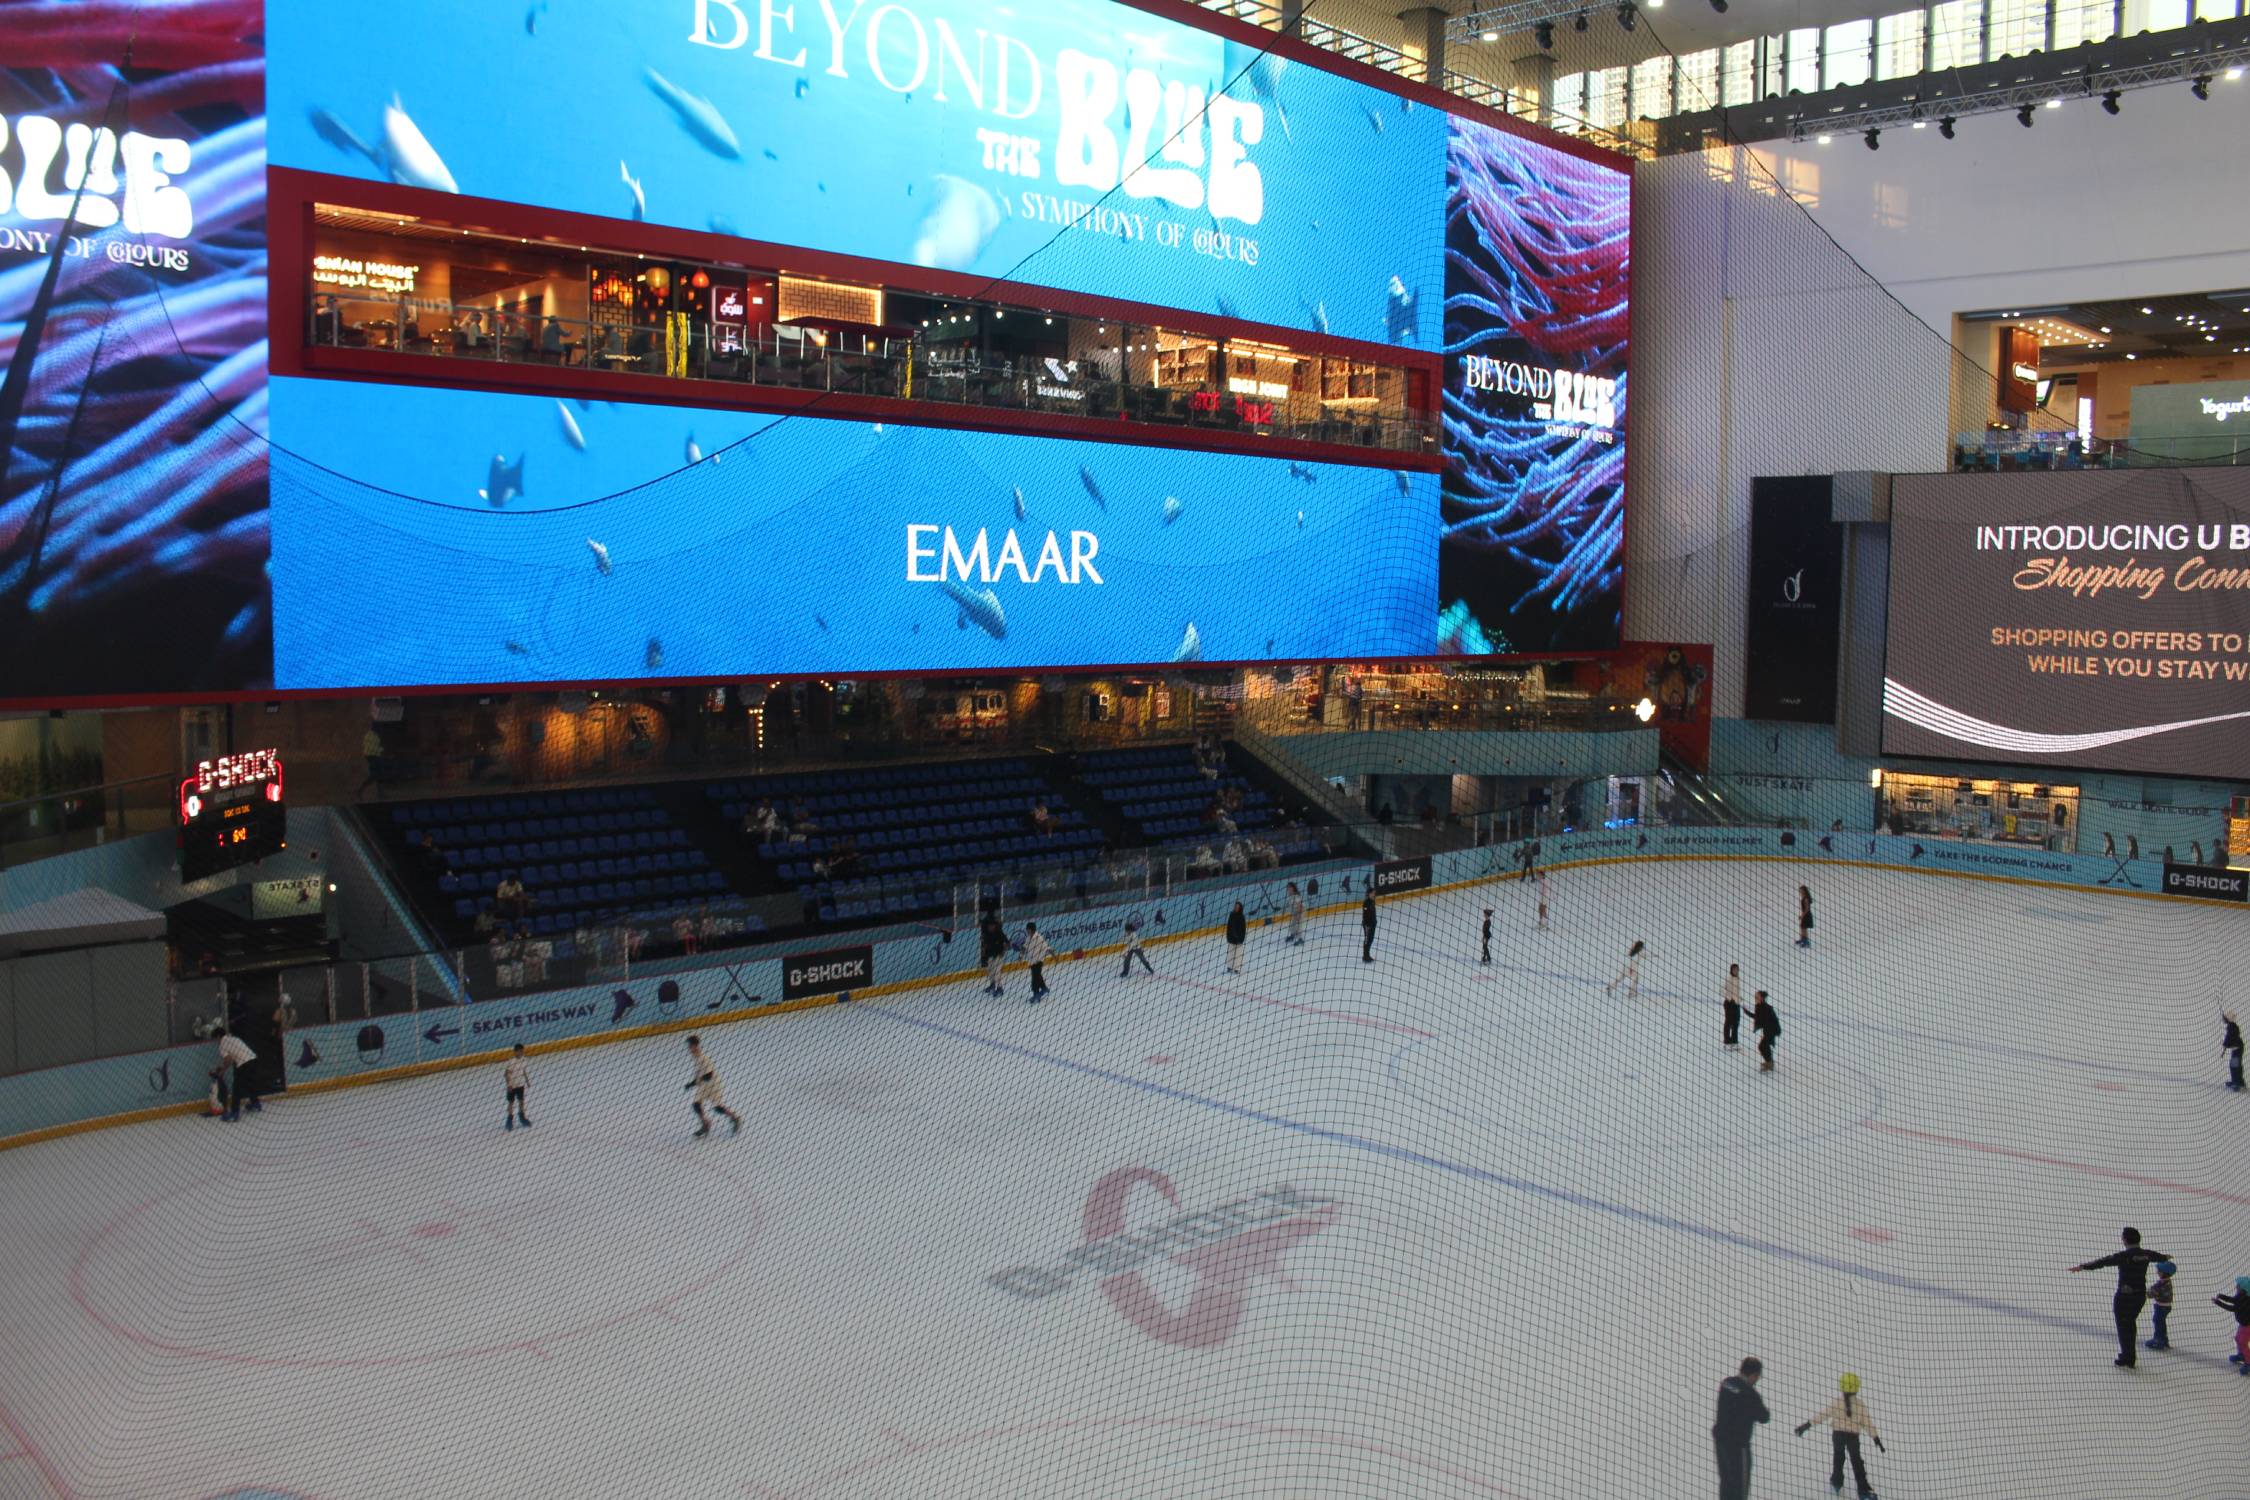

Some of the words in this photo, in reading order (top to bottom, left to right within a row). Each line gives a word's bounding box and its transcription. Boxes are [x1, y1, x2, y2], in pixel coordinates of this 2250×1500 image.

[976, 127, 1041, 179] THE
[1055, 48, 1264, 225] BLUE
[0, 113, 194, 239] LUE
[1021, 192, 1148, 241] SYMPHONY
[1156, 220, 1186, 248] OF
[1466, 354, 1552, 400] BEYOND
[1554, 369, 1616, 429] BLUE
[1976, 524, 2190, 550] INTRODUCING
[2198, 524, 2221, 550] U
[906, 523, 1104, 585] EMAAR
[2012, 555, 2166, 600] Shopping
[1991, 626, 2107, 649] SHOPPING
[2112, 630, 2202, 652] OFFERS
[2208, 632, 2242, 652] TO
[2027, 654, 2099, 676] WHILE
[2104, 657, 2151, 678] YOU
[2157, 659, 2219, 680] STAY
[2223, 661, 2250, 681] W
[198, 748, 277, 792] G-SHOCK
[1378, 866, 1421, 887] G-SHOCK
[1934, 850, 1959, 860] TAKE
[1962, 853, 1980, 862] THE
[1983, 855, 2029, 867] SCORING
[2030, 860, 2072, 872] CHANCE
[2169, 873, 2241, 892] G-SHOCK
[789, 959, 865, 987] G-SHOCK
[472, 1015, 524, 1034] SKATE
[526, 1008, 560, 1024] THIS
[561, 1003, 597, 1019] WAY
